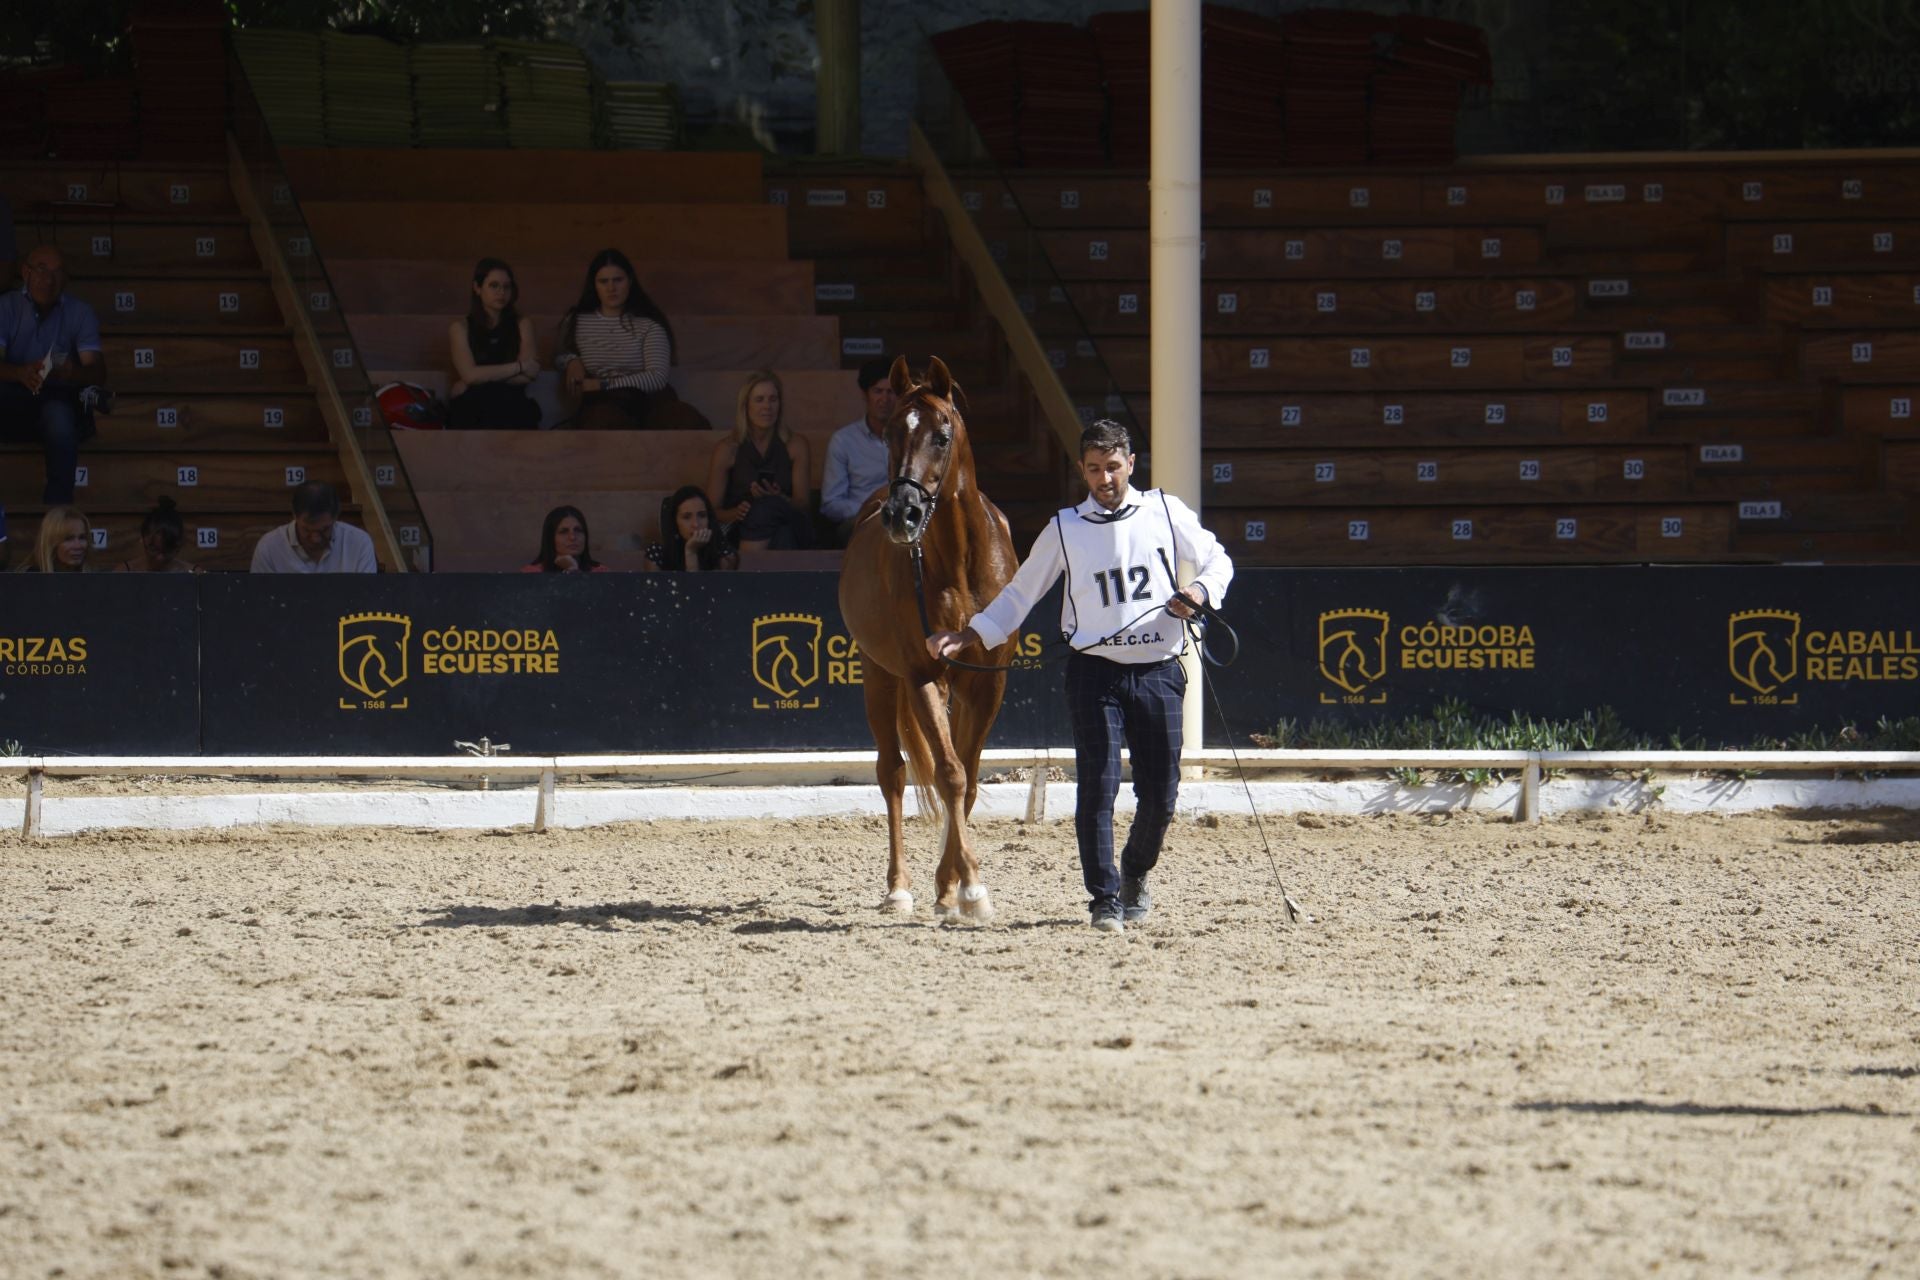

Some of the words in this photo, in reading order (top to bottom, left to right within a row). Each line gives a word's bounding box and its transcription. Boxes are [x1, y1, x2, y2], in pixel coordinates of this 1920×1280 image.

[70, 187, 85, 199] 22
[172, 187, 187, 199] 23
[868, 192, 885, 206] 52
[1587, 188, 1608, 198] FILA
[94, 239, 110, 252] 18
[198, 240, 214, 254] 19
[1385, 244, 1400, 255] 29
[1775, 236, 1790, 250] 31
[1090, 244, 1107, 257] 26
[1286, 244, 1303, 257] 28
[1593, 284, 1615, 293] FILA
[117, 295, 134, 309] 18
[221, 295, 237, 309] 19
[1120, 297, 1136, 310] 26
[1219, 296, 1236, 310] 27
[1318, 296, 1335, 309] 28
[1417, 295, 1434, 308] 29
[1517, 294, 1534, 307] 30
[1814, 290, 1829, 303] 31
[1629, 336, 1651, 345] FILA
[136, 351, 153, 365] 18
[242, 352, 257, 366] 19
[1251, 351, 1267, 365] 27
[1352, 351, 1369, 365] 28
[1452, 351, 1469, 364] 29
[1553, 350, 1570, 363] 30
[1853, 346, 1869, 359] 31
[1668, 393, 1690, 402] FILA
[1693, 392, 1699, 402] 7
[1385, 408, 1402, 421] 28
[1487, 407, 1503, 420] 29
[1588, 406, 1606, 419] 30
[1892, 401, 1908, 415] 31
[159, 411, 175, 425] 18
[265, 411, 282, 425] 19
[1282, 409, 1299, 422] 27
[1705, 449, 1727, 459] FILA
[1730, 449, 1737, 459] 6
[75, 469, 87, 483] 7
[179, 469, 196, 483] 18
[287, 469, 303, 483] 19
[1214, 466, 1231, 480] 26
[1316, 465, 1333, 479] 27
[1418, 465, 1435, 478] 28
[1521, 463, 1538, 477] 29
[1625, 462, 1642, 476] 30
[1744, 506, 1765, 516] FILA
[1769, 506, 1776, 515] 5
[1247, 524, 1264, 538] 26
[1350, 523, 1367, 537] 27
[1453, 523, 1471, 536] 28
[1557, 521, 1575, 535] 29
[1663, 520, 1680, 534] 30
[199, 530, 216, 544] 18
[1093, 564, 1152, 608] 112
[422, 625, 559, 651] CÓRDOBA
[1100, 631, 1165, 647] A.E.C.C.A.
[1401, 621, 1535, 647] CÓRDOBA
[1805, 630, 1920, 654] CABALL
[0, 638, 87, 661] RIZAS
[423, 653, 559, 674] ECUESTRE
[1401, 649, 1535, 669] ECUESTRE
[6, 662, 87, 675] CÓRDOBA
[1806, 656, 1919, 680] REALES
[362, 701, 385, 709] 1568
[774, 700, 800, 709] 1568
[1752, 695, 1778, 705] 1568
